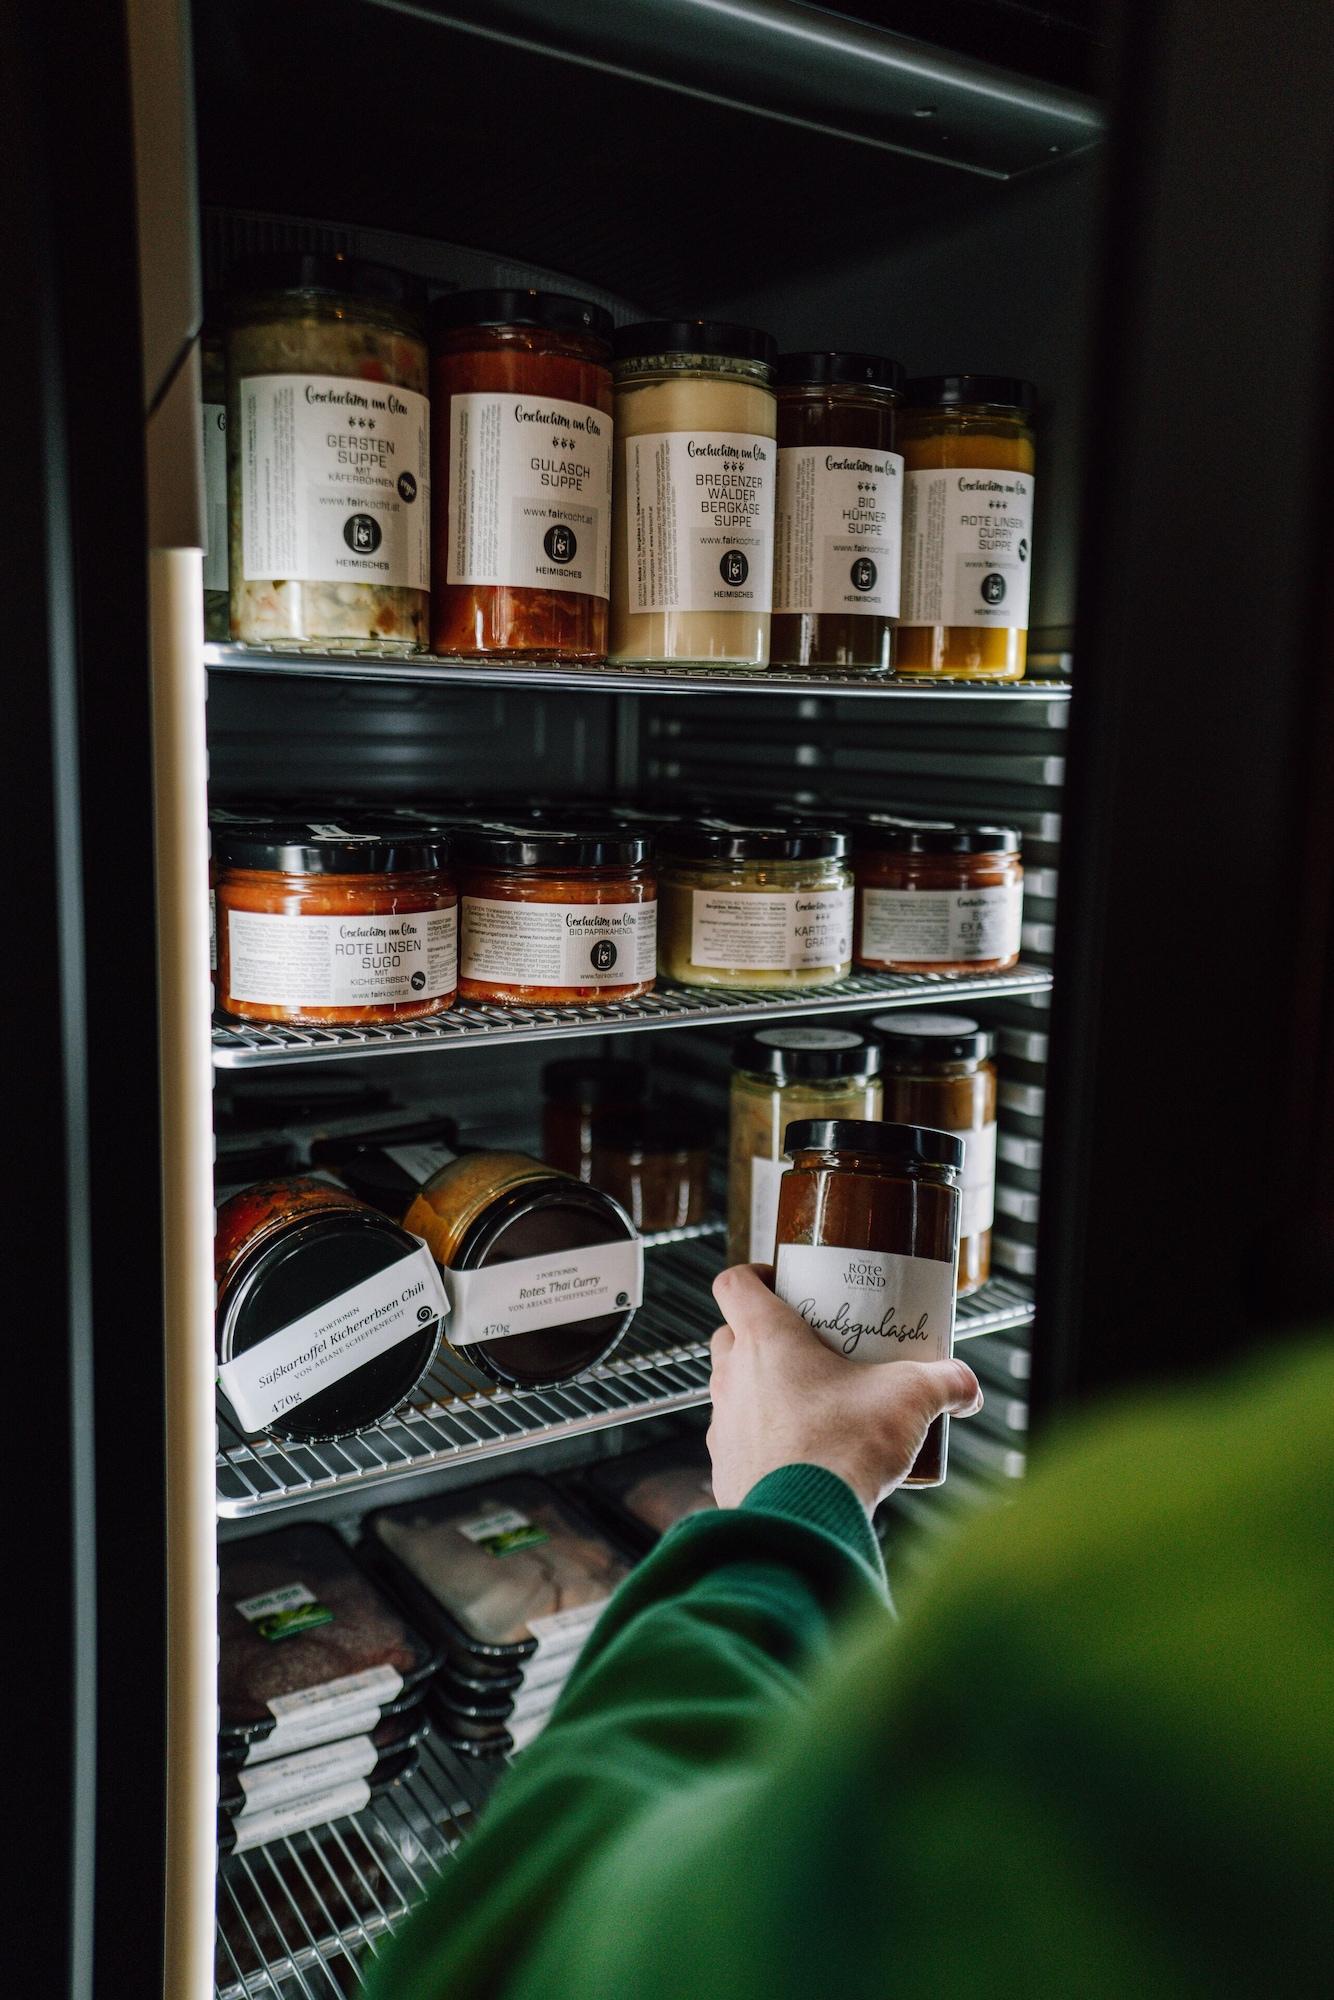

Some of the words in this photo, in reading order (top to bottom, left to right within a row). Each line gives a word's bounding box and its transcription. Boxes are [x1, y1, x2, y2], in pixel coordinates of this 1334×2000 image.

[306, 385, 368, 409] Geschichten
[515, 404, 570, 430] Geschichten
[327, 434, 395, 455] GERSTEN
[687, 440, 740, 460] Geschichten
[337, 451, 388, 468] SUPPE
[355, 467, 371, 476] MIT
[531, 458, 590, 479] GULASCH
[328, 473, 395, 488] KÄFERBOHNEN
[541, 474, 583, 492] SUPPE
[696, 474, 763, 489] BREGENZER
[708, 486, 756, 501] WÄLDER
[319, 496, 400, 513] www.fairkocht.at
[701, 500, 760, 516] BERGKÄSE
[858, 497, 876, 508] BIO
[523, 506, 593, 526] www.fairkocht.at
[714, 515, 752, 528] SUPPE
[842, 508, 886, 523] HÜHNER
[961, 515, 992, 527] ROTE
[848, 523, 883, 536] SUPPE
[978, 541, 1012, 552] SUPPE
[335, 558, 390, 571] HEIMISCHES
[536, 566, 582, 579] HEIMISCHES
[714, 590, 754, 600] HEIMISCHES
[566, 913, 610, 928] Geschichten
[795, 924, 843, 936] KARTO
[335, 943, 373, 956] ROTE
[376, 940, 422, 954] LINSEN
[805, 937, 837, 948] GRAT
[362, 956, 400, 969] SUGO
[350, 976, 410, 986] KICHERERBSEN
[542, 1266, 578, 1280] PORTIONEN
[519, 1286, 546, 1300] Rotes
[548, 1281, 572, 1294] Thai
[574, 1276, 602, 1290] Curry
[508, 1304, 524, 1313] VON
[526, 1298, 554, 1311] ARIANE
[319, 1306, 361, 1335] PORTIONEN
[258, 1339, 328, 1390] Süßkartoffel
[329, 1298, 400, 1348] Kichererbsen
[400, 1282, 426, 1303] Chili
[482, 1323, 511, 1336] 470g
[293, 1366, 314, 1381] VON
[314, 1348, 345, 1370] ARIANE
[345, 1309, 406, 1352] SCHEFFKNECHT
[271, 1391, 304, 1414] 470g
